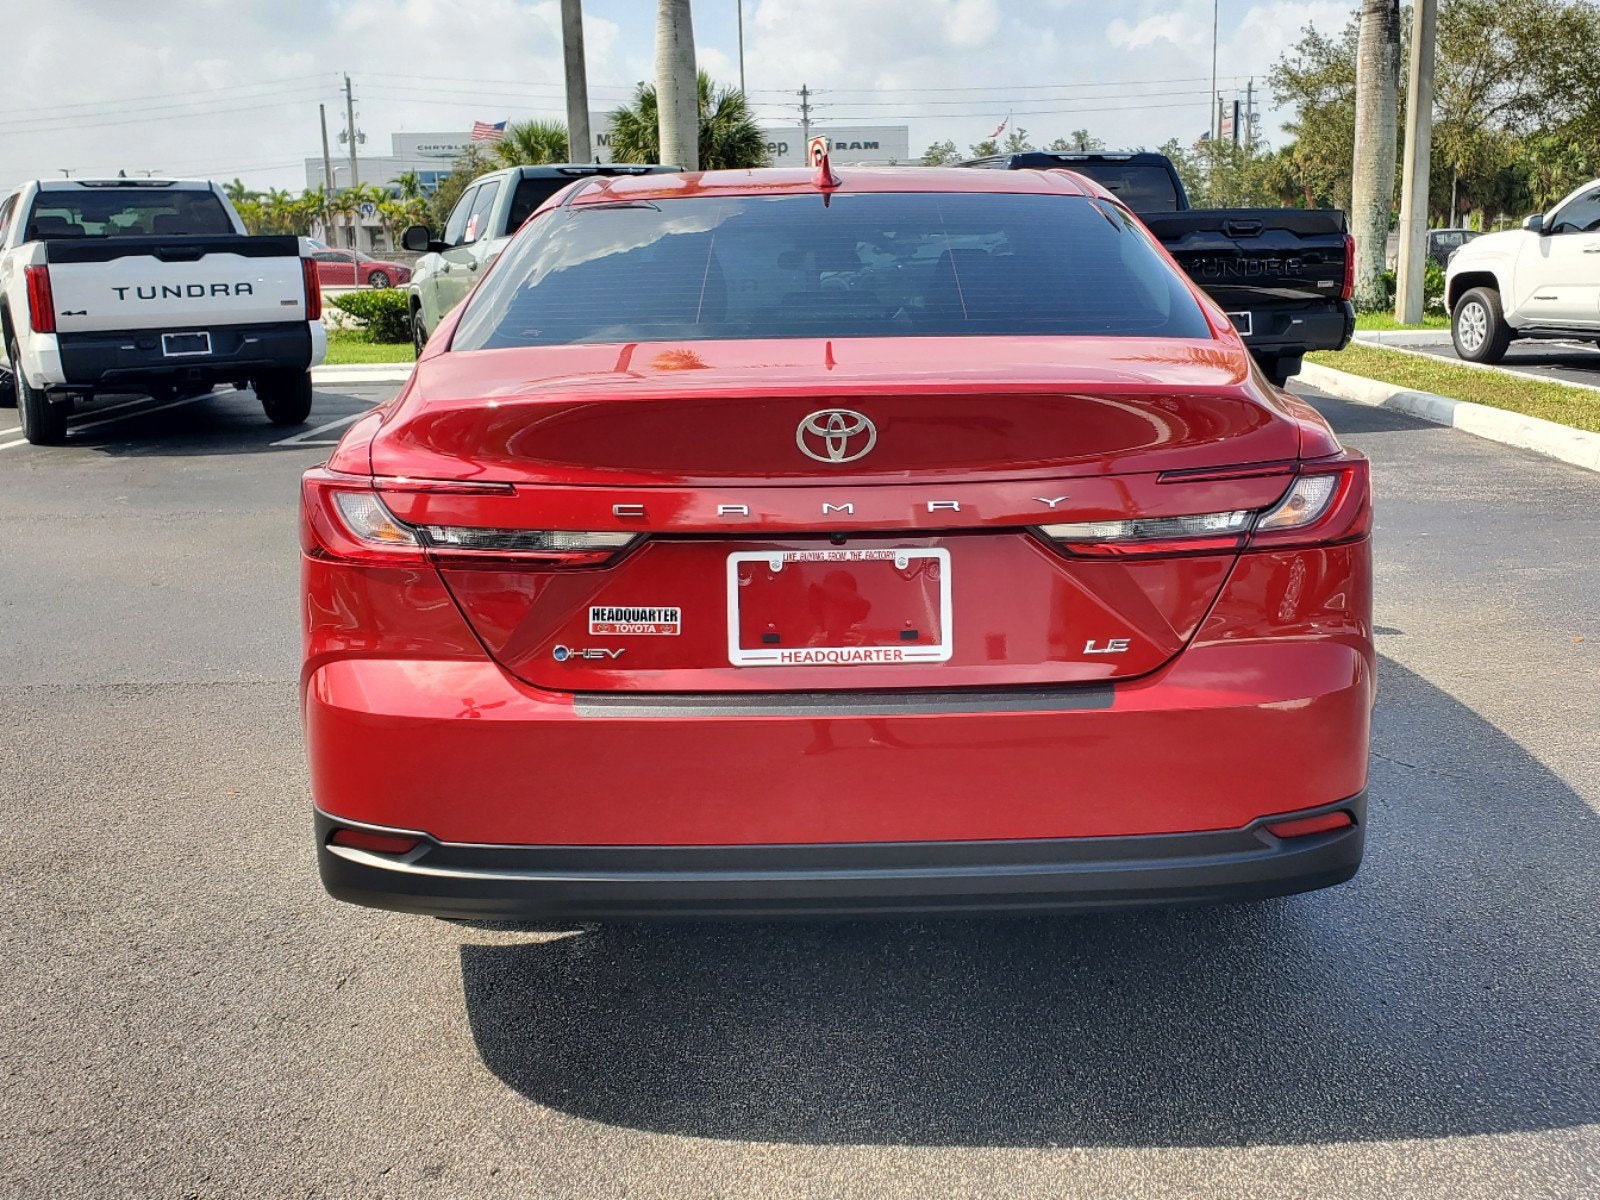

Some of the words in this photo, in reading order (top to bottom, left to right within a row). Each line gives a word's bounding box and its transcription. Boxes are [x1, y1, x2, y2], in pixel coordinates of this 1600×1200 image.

[835, 141, 880, 150] RAM
[1181, 256, 1303, 278] TUNDRA
[112, 282, 254, 301] TUNDRA
[612, 496, 1069, 517] CAMRY
[782, 552, 797, 561] LIKE
[800, 552, 825, 561] BUYING
[828, 551, 847, 561] FROM
[850, 551, 862, 560] THE
[592, 608, 678, 623] HEADQUARTER
[614, 624, 657, 633] TOYOTA
[1083, 638, 1131, 655] LE
[781, 649, 903, 663] HEADQUARTER
